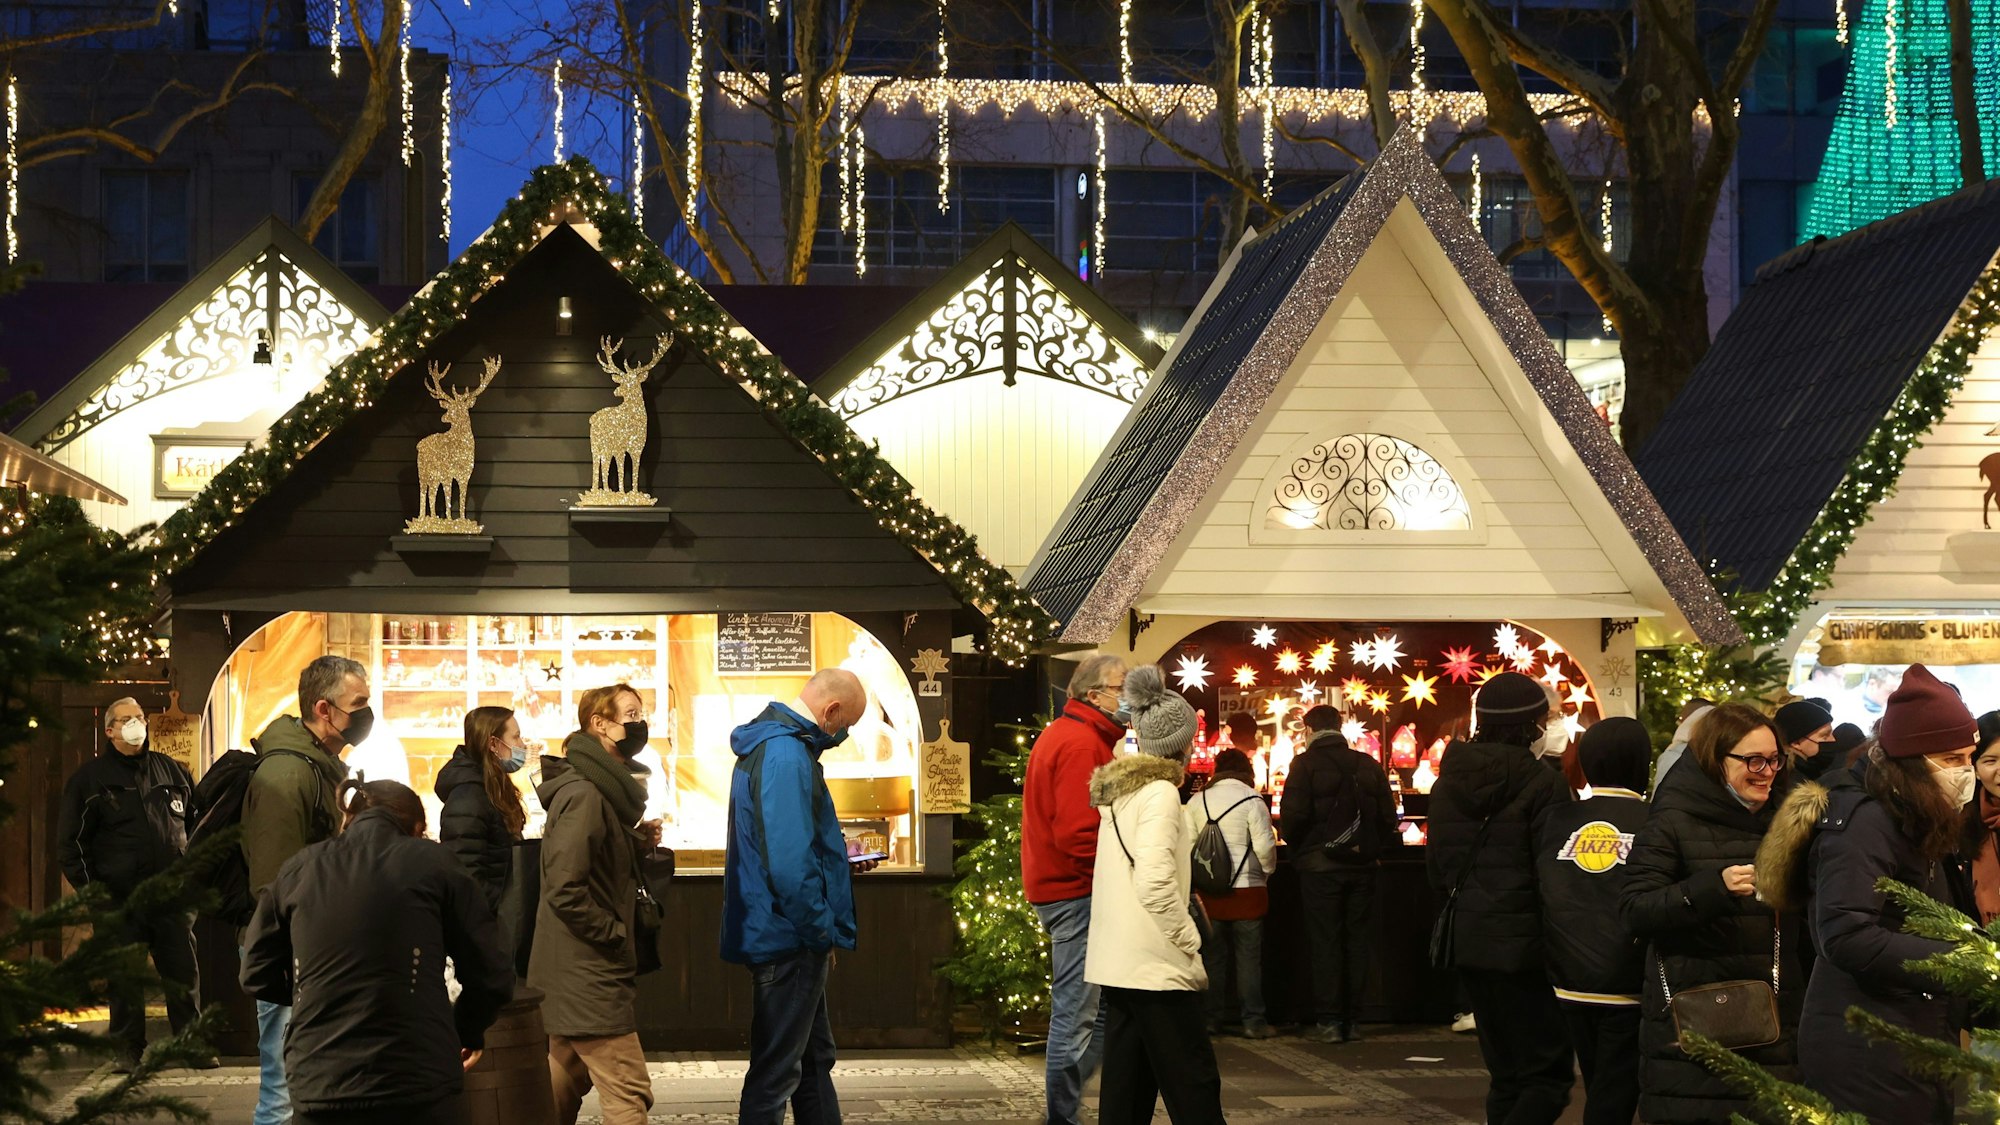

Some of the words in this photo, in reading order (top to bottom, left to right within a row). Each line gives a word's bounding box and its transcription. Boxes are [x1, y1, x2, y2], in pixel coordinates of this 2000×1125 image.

[1829, 621, 1926, 640] CHAMPIGNONS
[1942, 622, 2000, 640] BLUMEN
[923, 683, 938, 693] 44
[1609, 687, 1622, 697] 43
[926, 745, 947, 762] Jede
[1563, 834, 1633, 860] LAKERS
